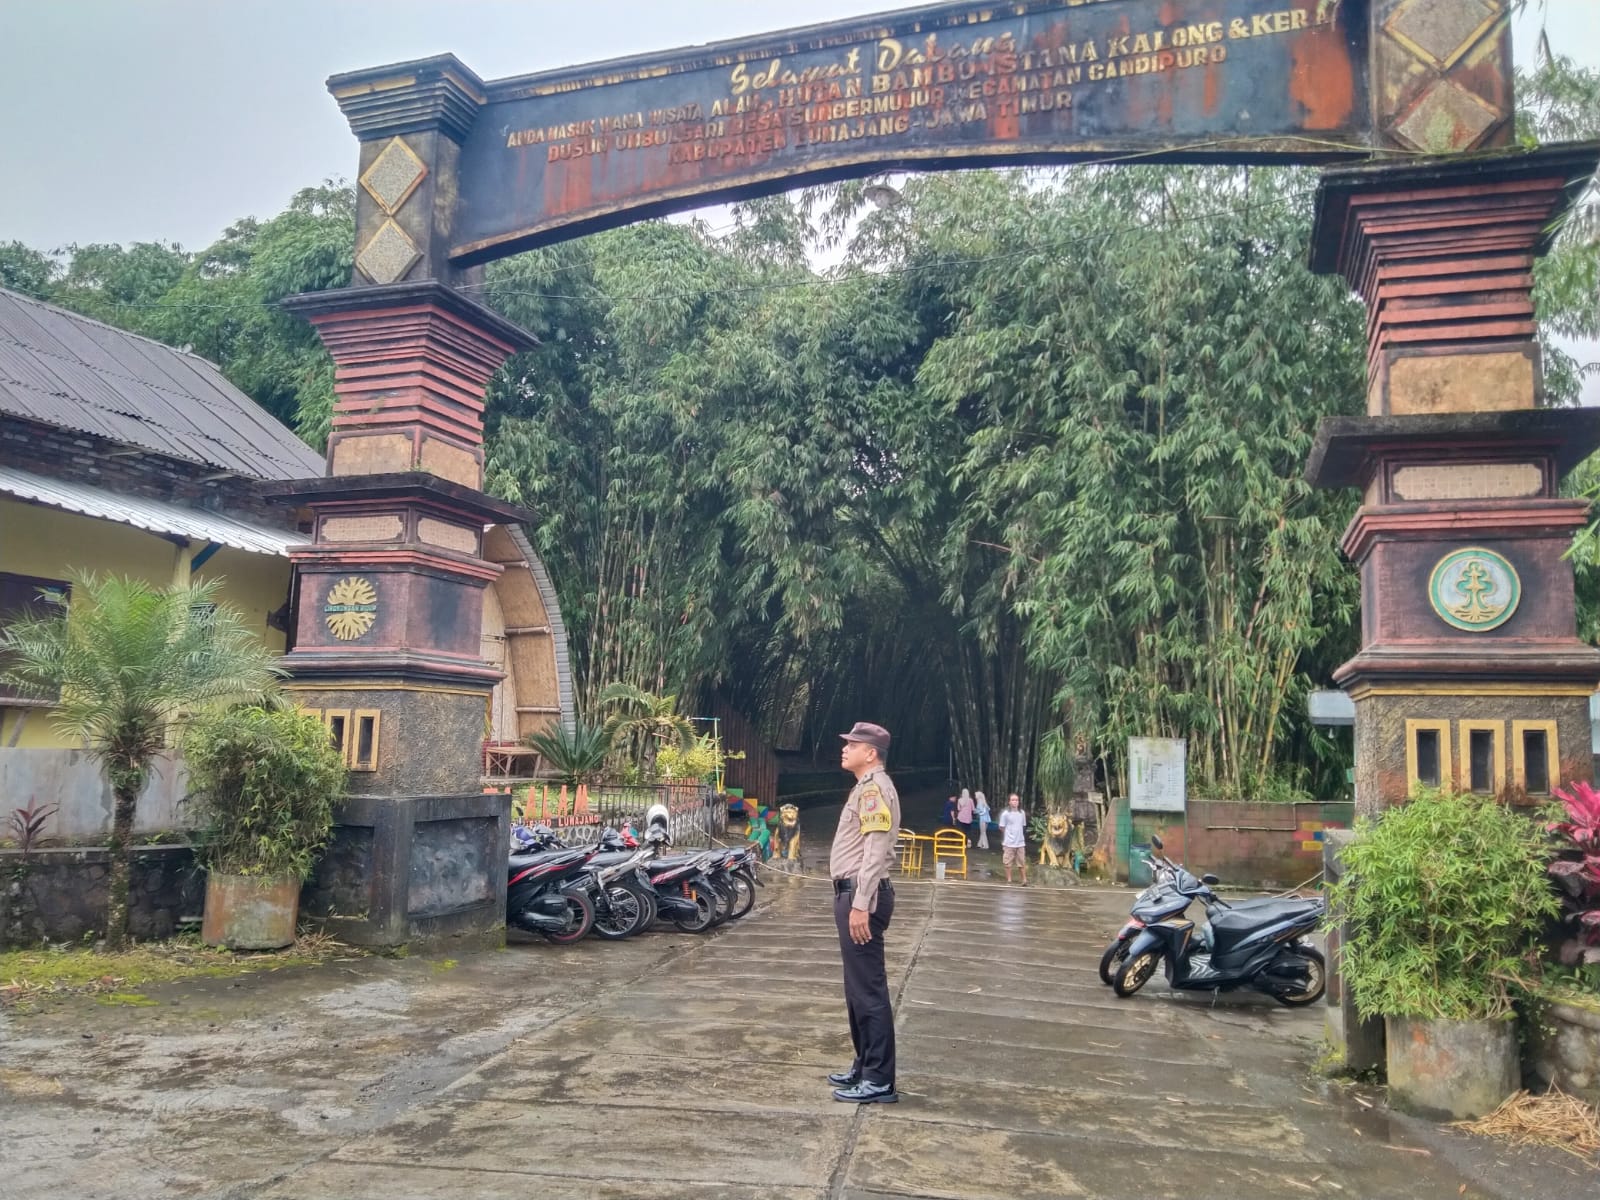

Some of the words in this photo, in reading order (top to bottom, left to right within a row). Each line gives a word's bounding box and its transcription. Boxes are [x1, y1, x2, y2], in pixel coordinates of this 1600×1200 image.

[506, 131, 545, 148] ANDA
[547, 118, 596, 141] MASUK
[599, 112, 644, 132] WANA
[649, 103, 704, 126] WISATA
[988, 38, 1099, 75] ISTANA
[1107, 21, 1224, 58] KALONG
[547, 137, 608, 163] DUSUN
[1088, 45, 1227, 81] CANDIPURO
[731, 47, 862, 94] Selamat
[878, 31, 1016, 73] Datang
[669, 132, 786, 164] KABUPATEN
[794, 114, 910, 147] LUMAJANG
[925, 103, 987, 129] JAWA
[999, 90, 1072, 117] TIMUR
